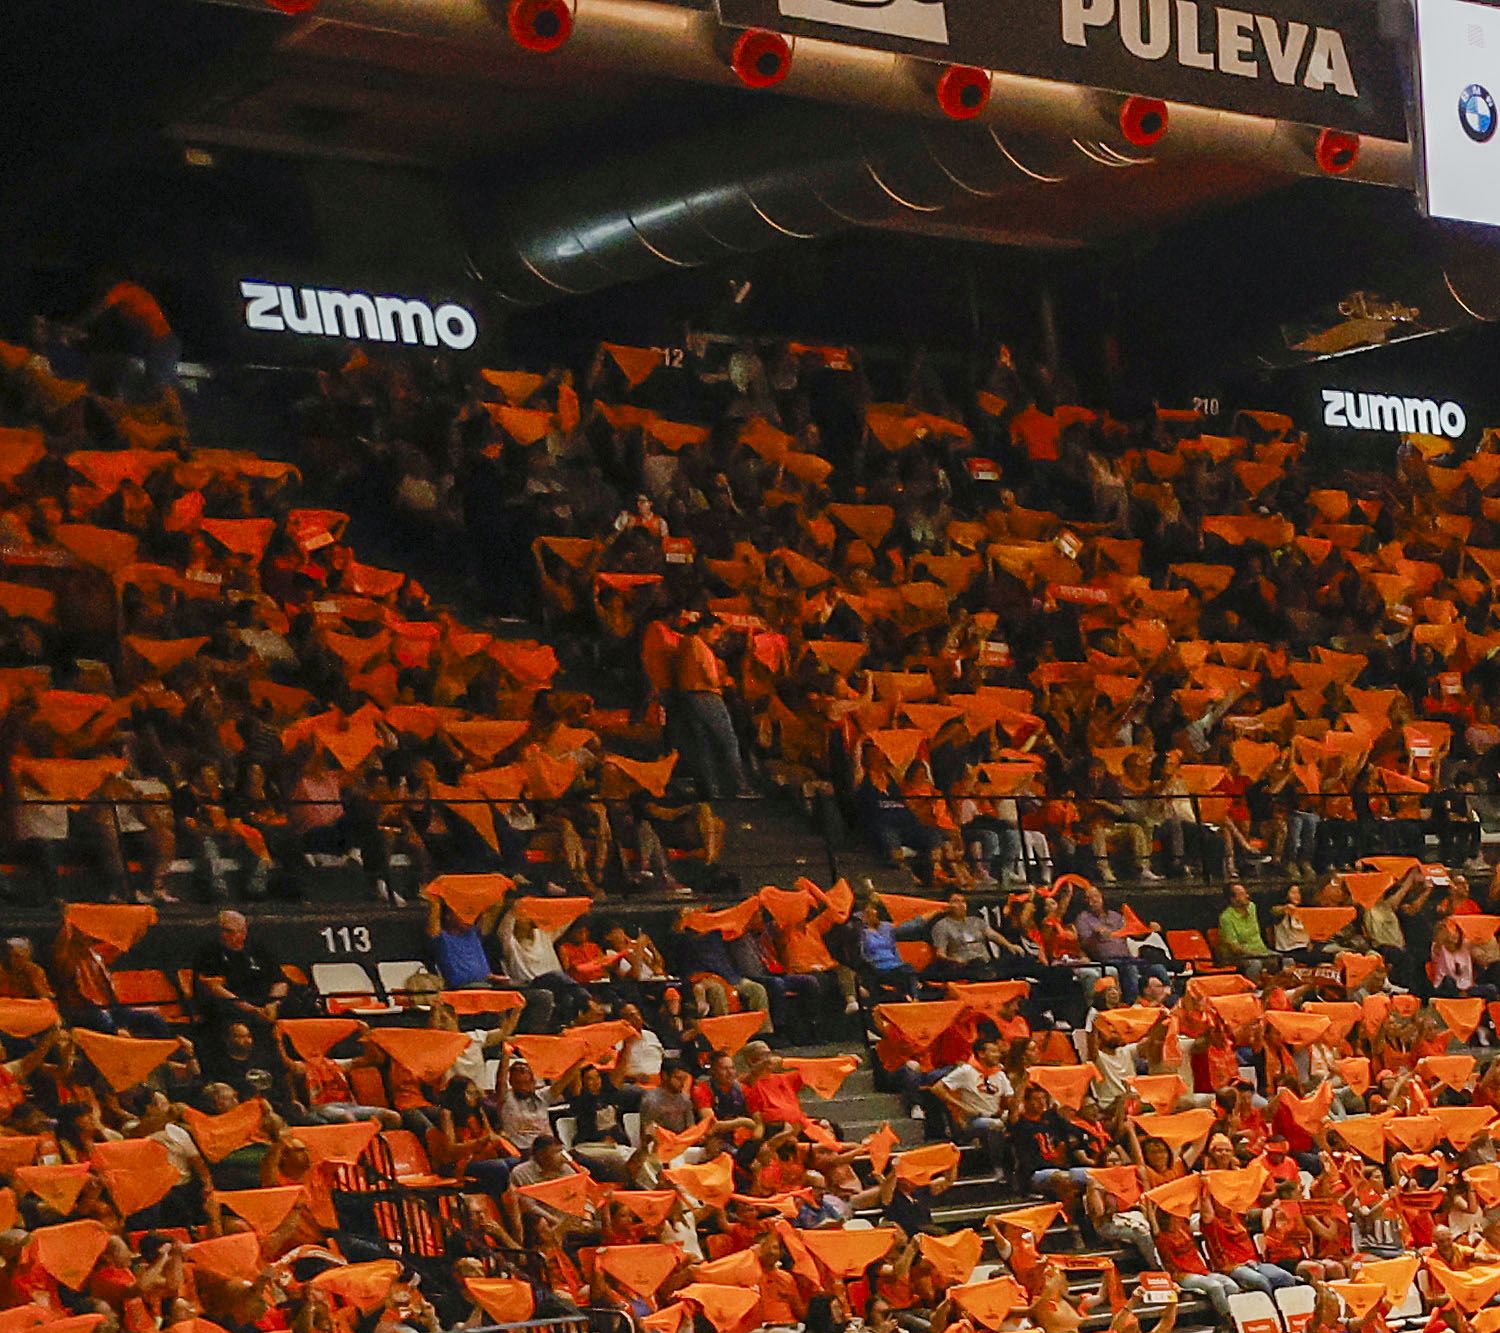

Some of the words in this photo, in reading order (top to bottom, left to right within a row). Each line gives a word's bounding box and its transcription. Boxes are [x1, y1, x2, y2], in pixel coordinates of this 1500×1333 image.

[1062, 0, 1358, 97] PULEVA
[241, 282, 476, 349] zummo
[1322, 390, 1465, 437] zummo
[321, 927, 371, 952] 113
